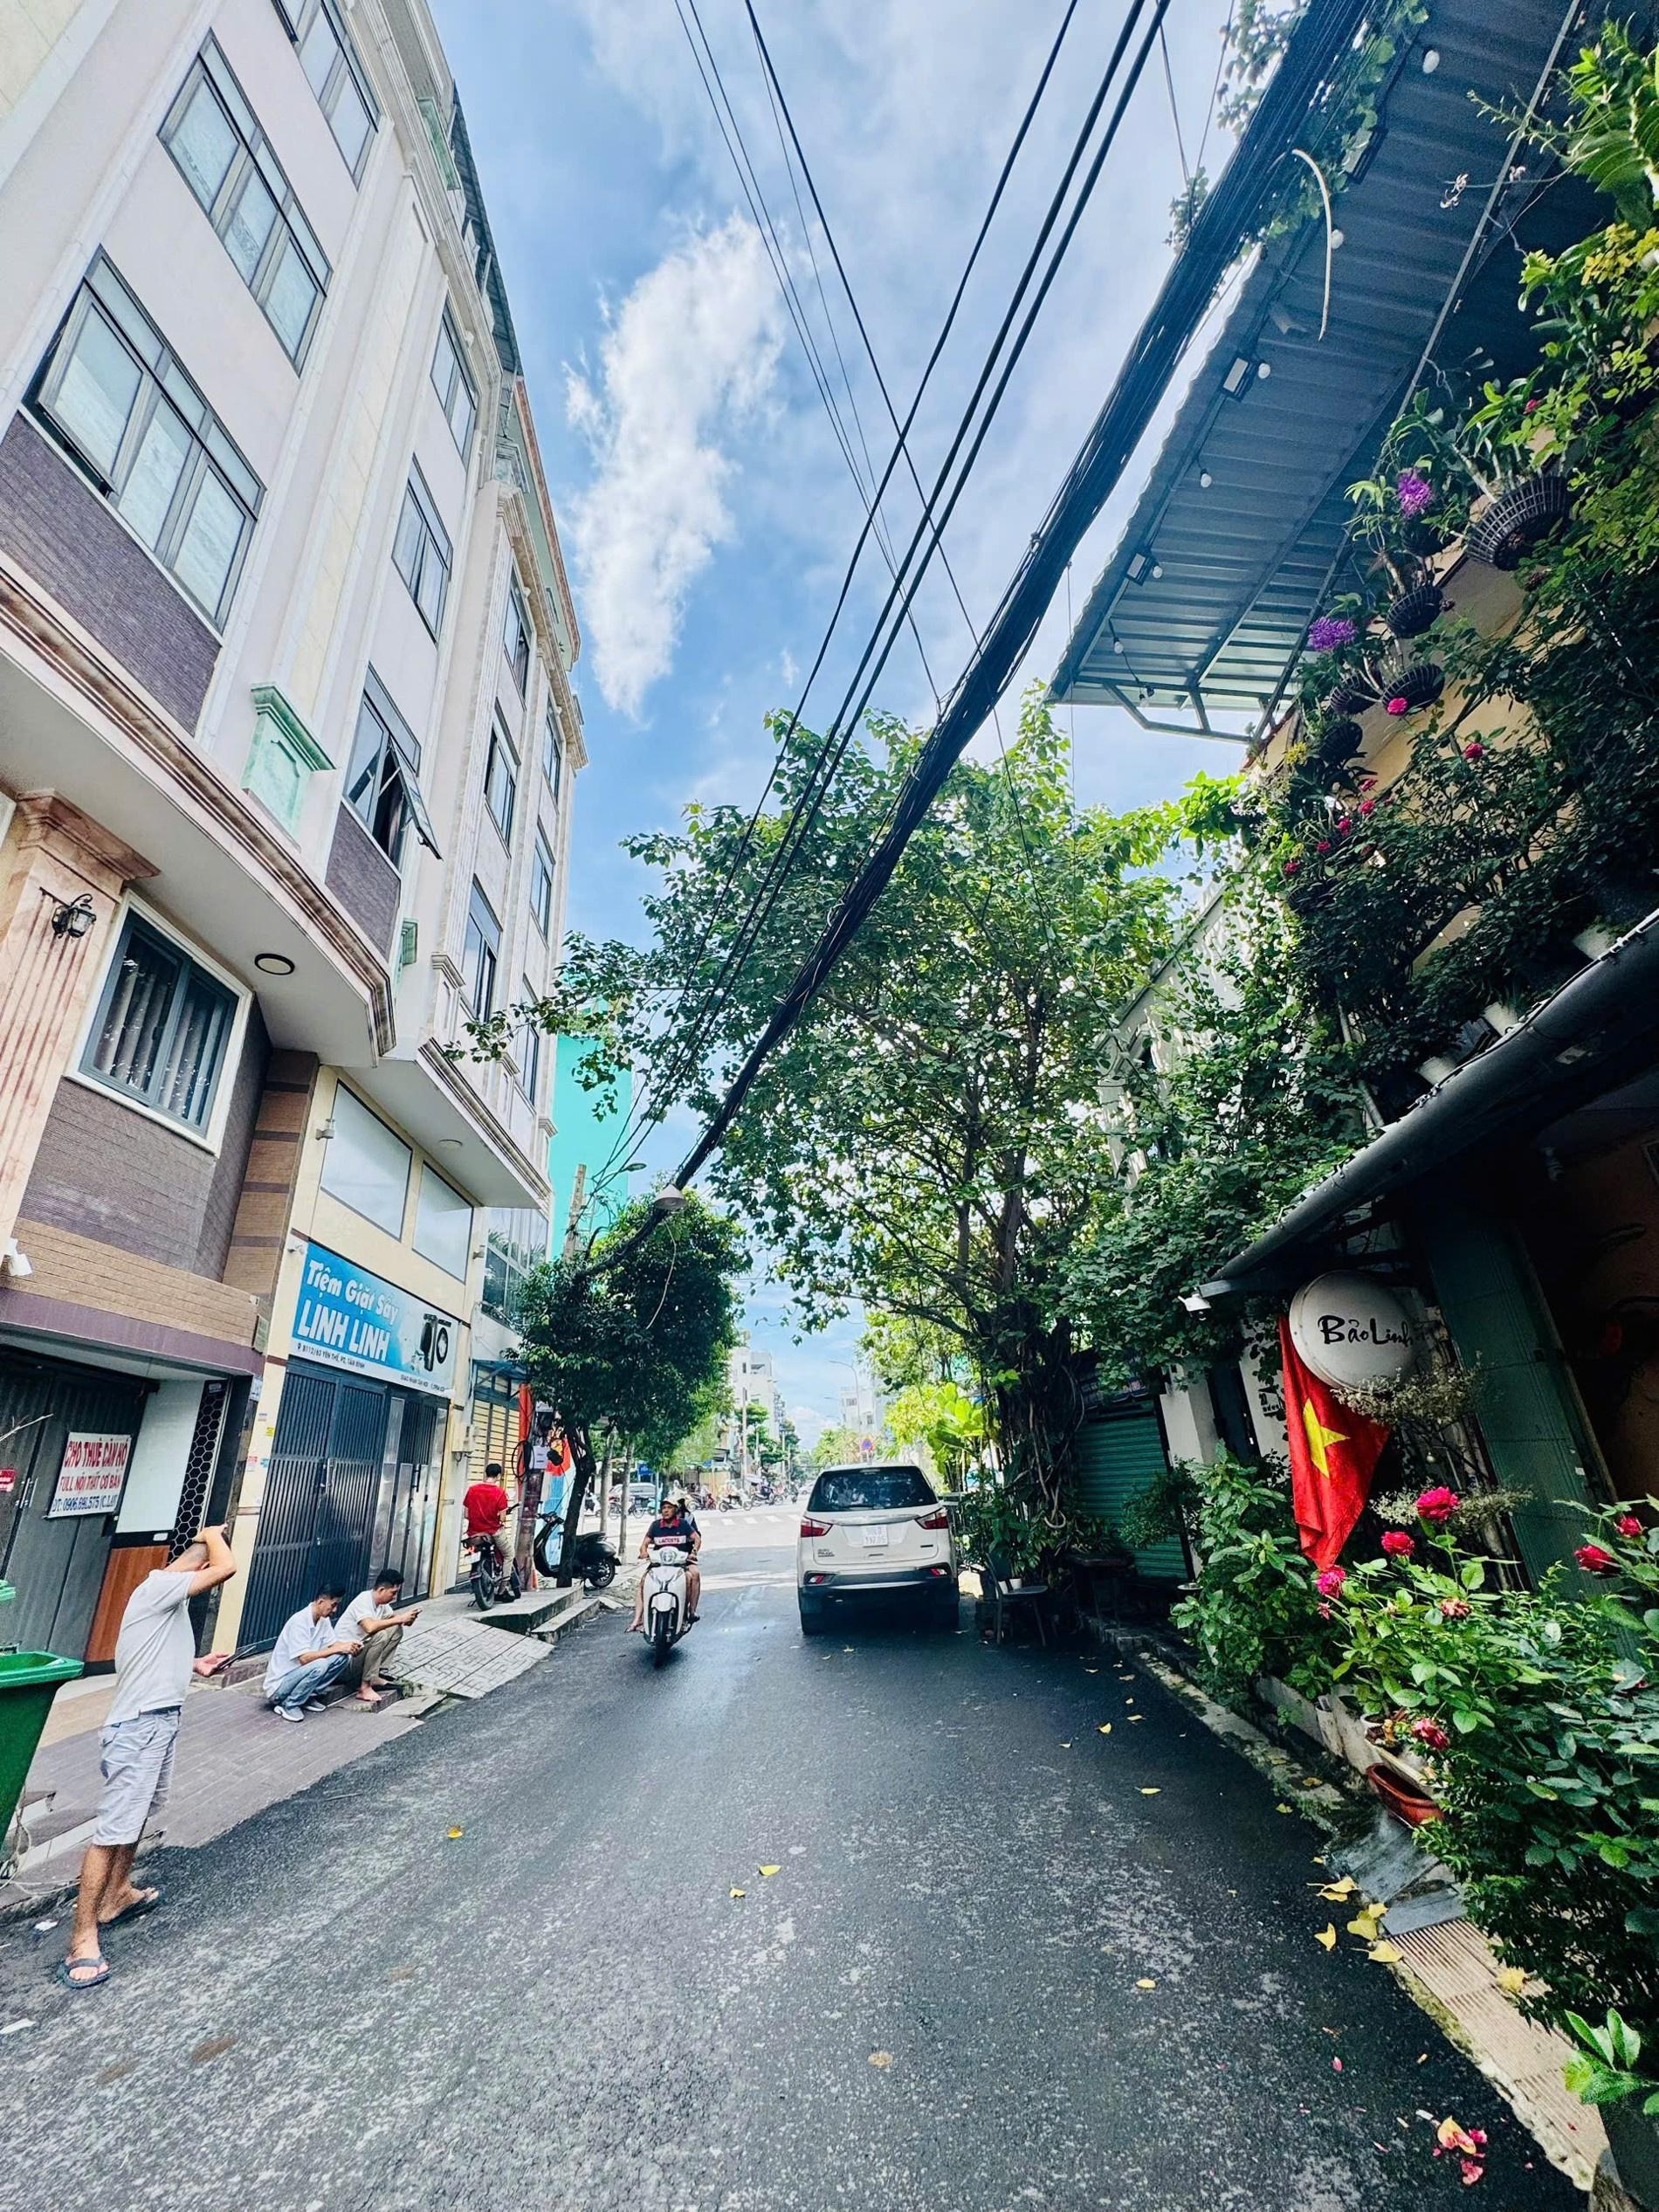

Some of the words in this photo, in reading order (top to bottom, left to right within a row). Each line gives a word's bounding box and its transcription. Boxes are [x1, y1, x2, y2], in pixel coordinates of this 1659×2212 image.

[306, 1259, 342, 1299] Tiệm
[345, 1278, 375, 1315] Giặt
[375, 1293, 399, 1326] Sấy
[297, 1299, 350, 1348] LINH
[349, 1318, 391, 1362] LINH
[1317, 1314, 1369, 1345] Bảo
[1369, 1318, 1414, 1347] Linh
[64, 1440, 82, 1468] CHO
[82, 1437, 103, 1468] THUÊ
[102, 1438, 118, 1468] CĂN
[115, 1438, 128, 1470] HỘ
[59, 1476, 74, 1492] FULL
[74, 1472, 86, 1494] NỘI
[86, 1471, 101, 1491] THẤT
[100, 1473, 111, 1490] CƠ
